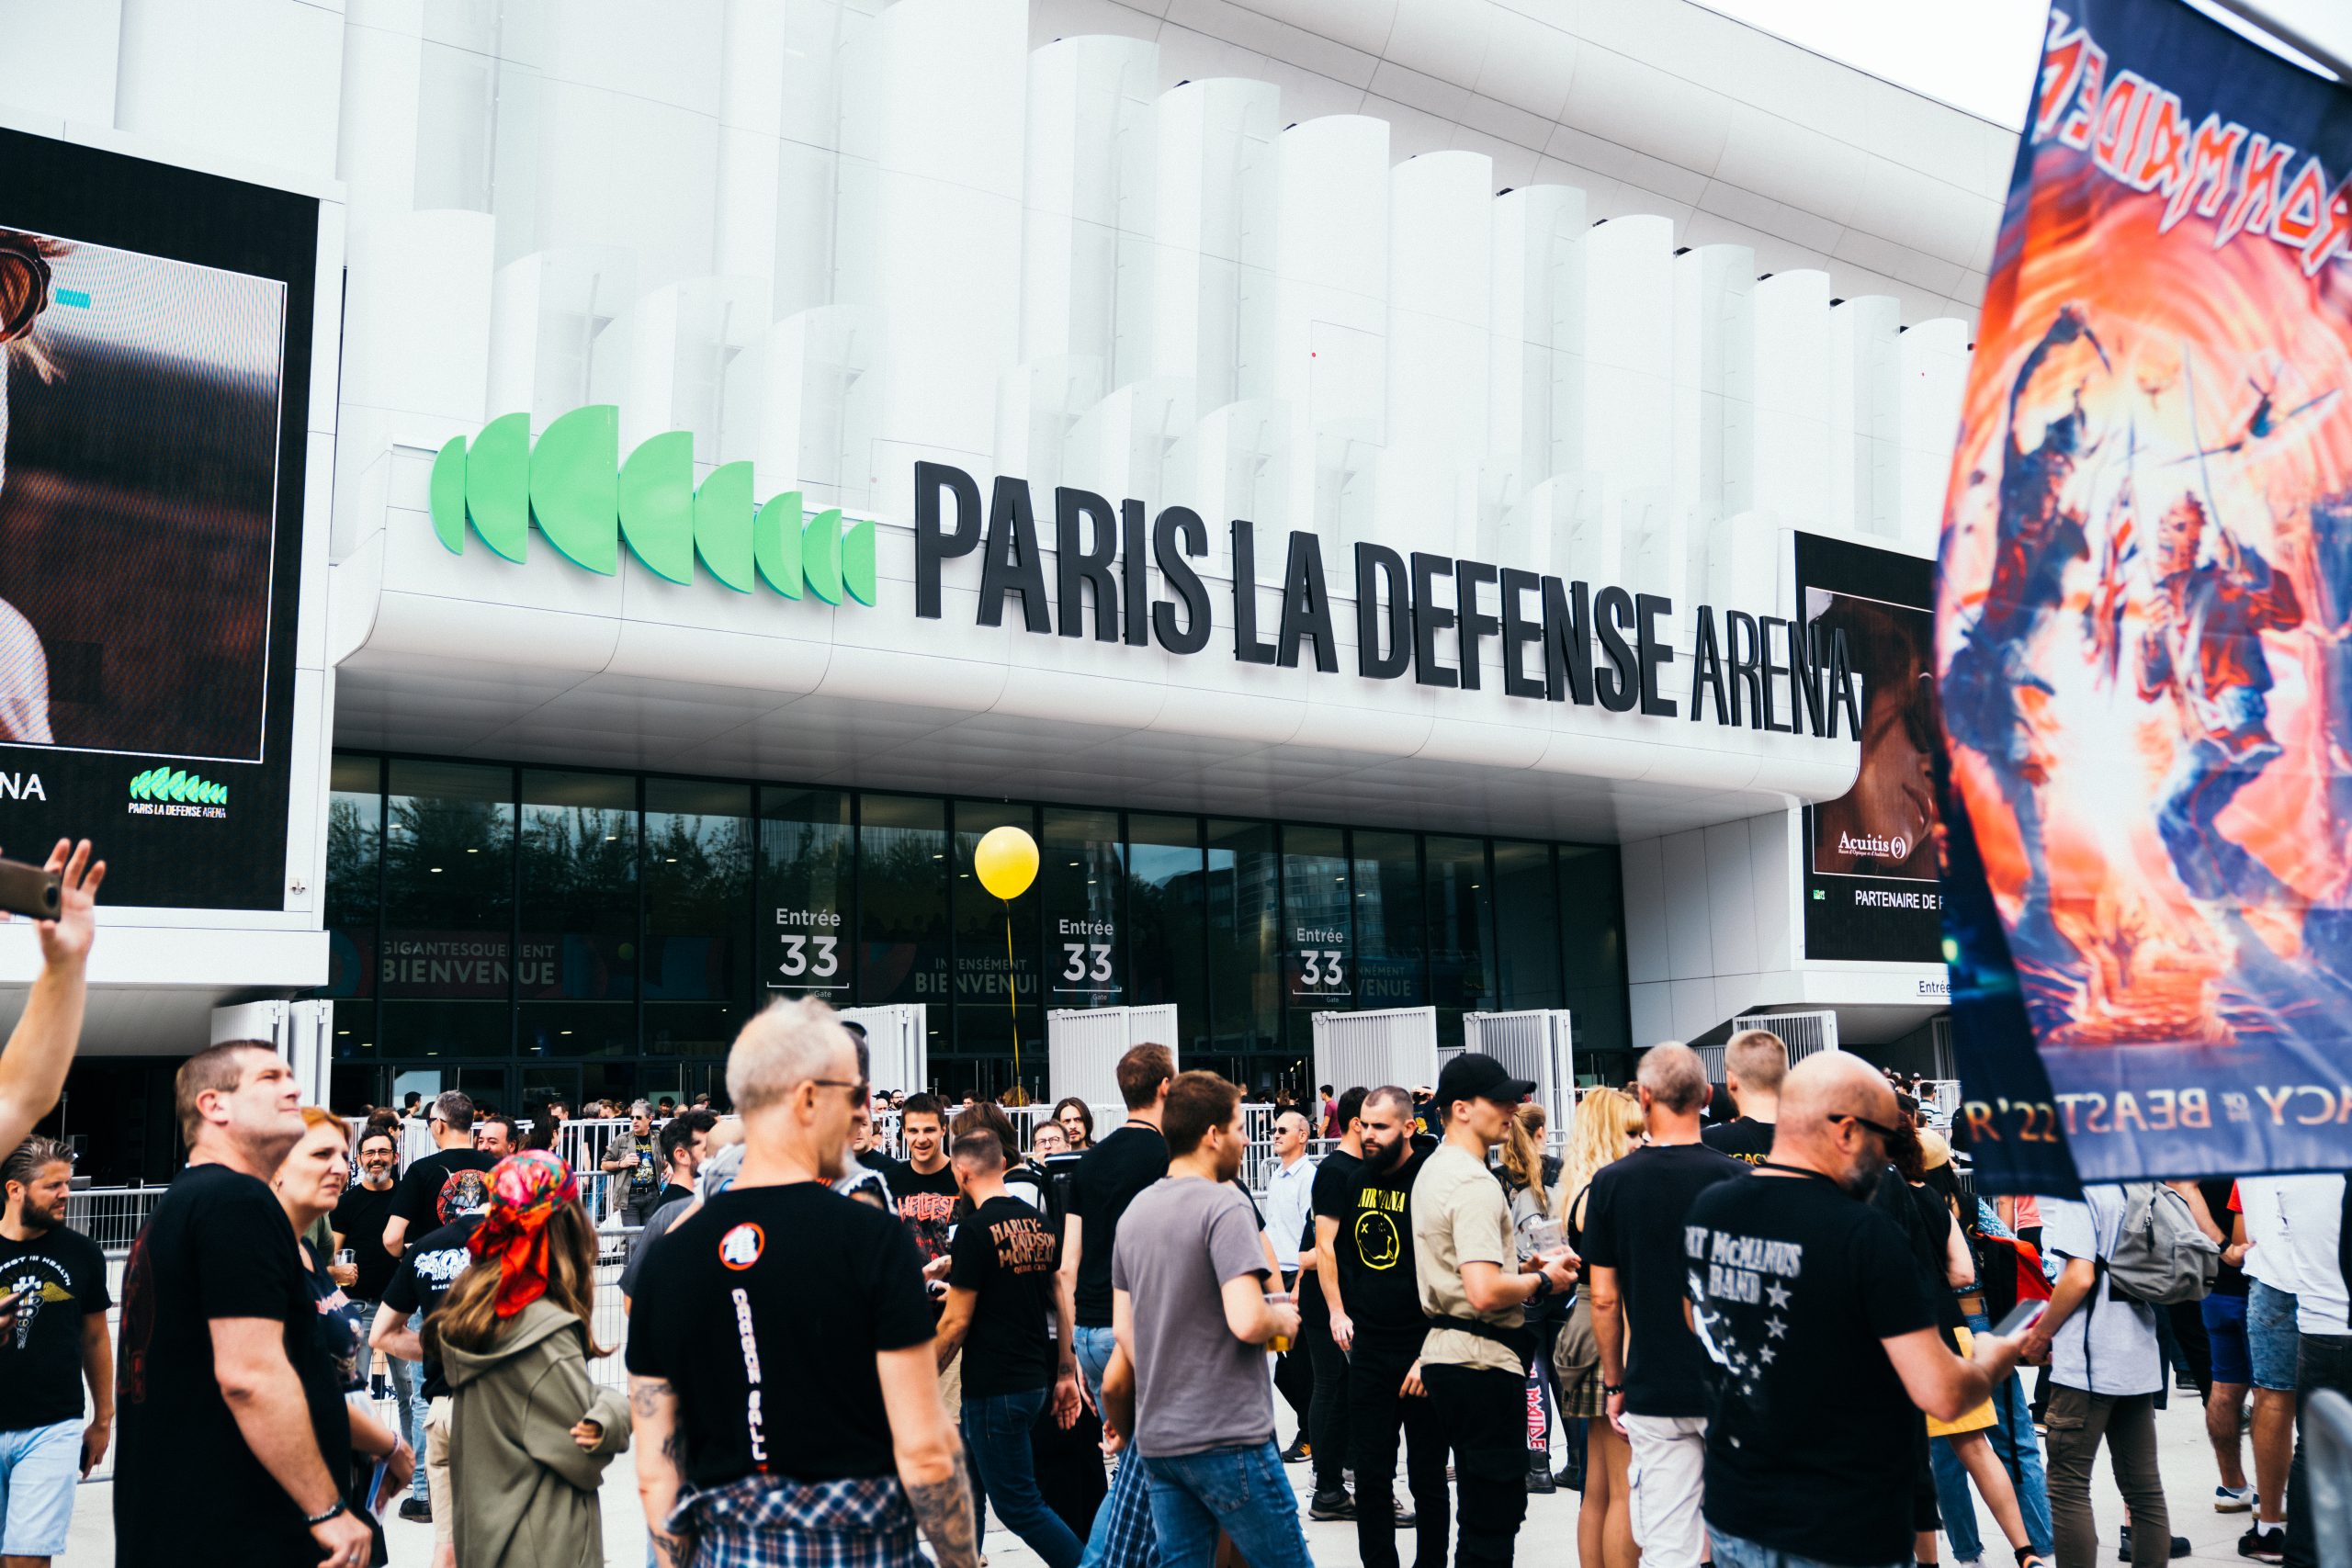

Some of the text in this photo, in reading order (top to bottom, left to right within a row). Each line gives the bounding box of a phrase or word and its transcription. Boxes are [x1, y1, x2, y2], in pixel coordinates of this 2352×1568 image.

[915, 460, 1862, 742] PARIS LA DEFENSE ARENA
[128, 802, 226, 818] PARIS LA DEFENSE ARENA
[1838, 830, 1890, 852] Acuitis
[1855, 889, 1920, 908] PARTENAIRE
[1922, 895, 1937, 910] DE
[776, 908, 841, 927] Entrée
[1058, 919, 1114, 936] Entrée
[1296, 927, 1343, 943] Entrée
[383, 941, 555, 958] GIGANTESQUEENT
[779, 934, 838, 977] 33
[1062, 942, 1114, 982] 33
[382, 958, 555, 985] BIENVENUE
[935, 955, 1027, 971] INENSÉMENT
[1300, 950, 1343, 986] 33
[1918, 980, 1951, 993] Entrée
[898, 1192, 961, 1224] HELLFEST
[1358, 1188, 1406, 1213] NIRVANA
[1710, 1230, 1803, 1279] McMANUS
[1709, 1264, 1761, 1304] BAND
[1526, 1384, 1547, 1452] MAIDE
